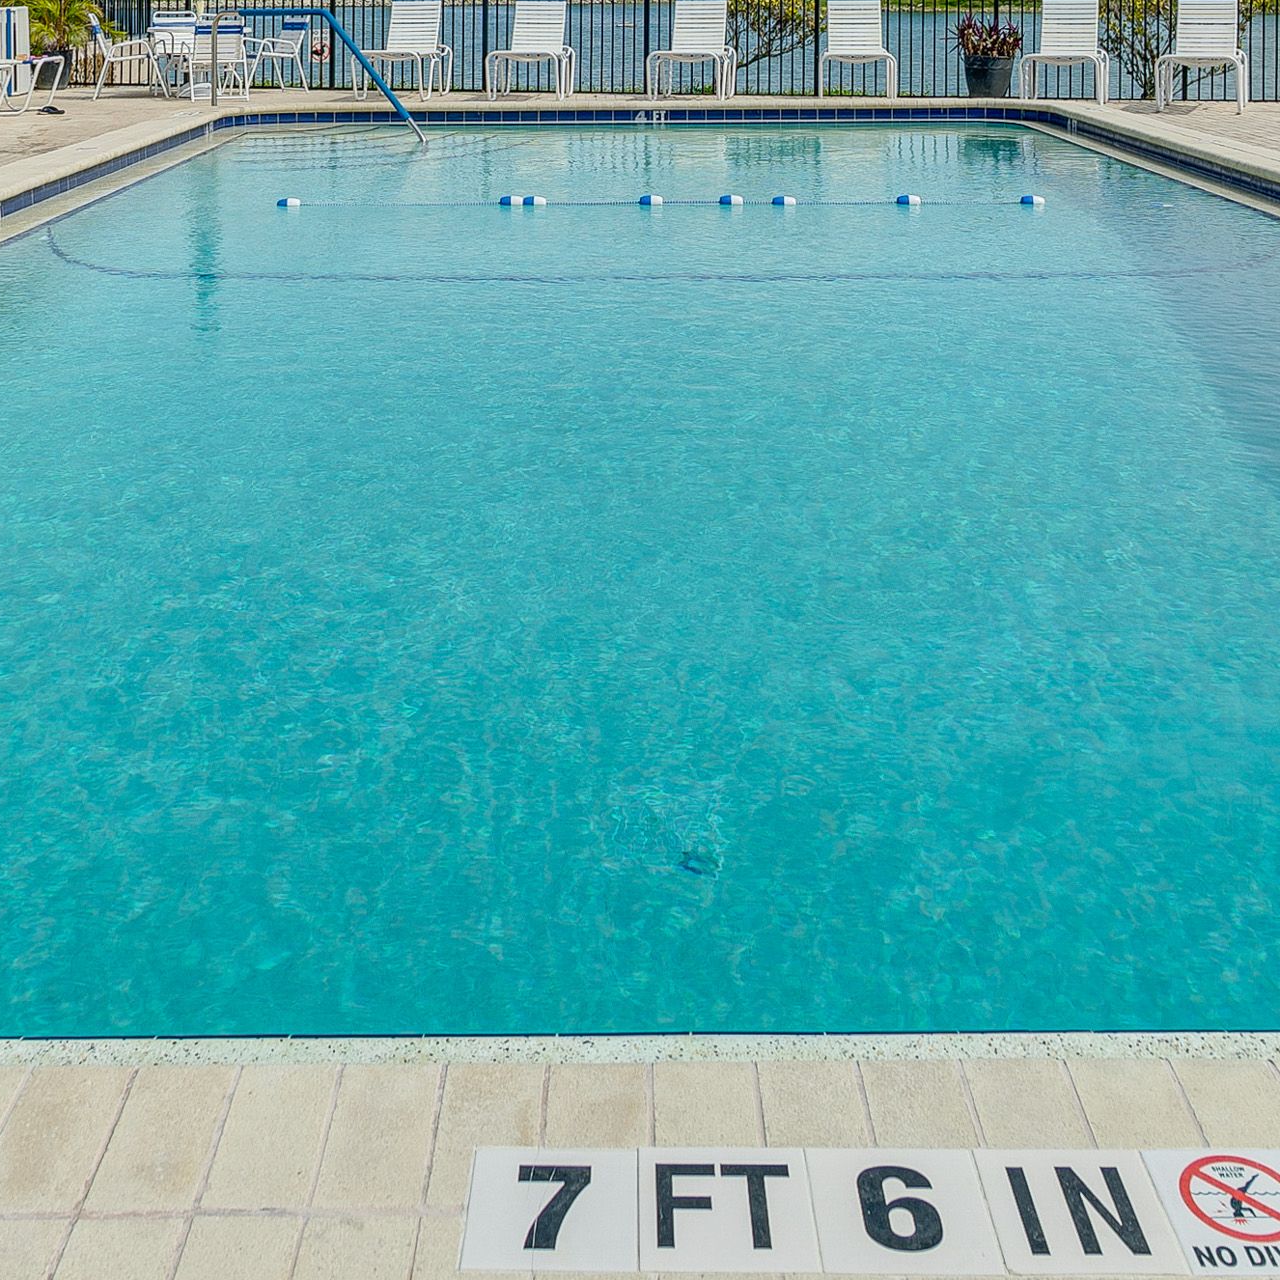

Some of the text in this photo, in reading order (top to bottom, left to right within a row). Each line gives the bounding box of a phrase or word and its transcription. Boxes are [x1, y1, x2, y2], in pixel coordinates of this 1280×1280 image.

[635, 110, 666, 121] 4 FT
[518, 1163, 1152, 1255] 7 FT 6 IN
[1193, 1246, 1238, 1267] NO
